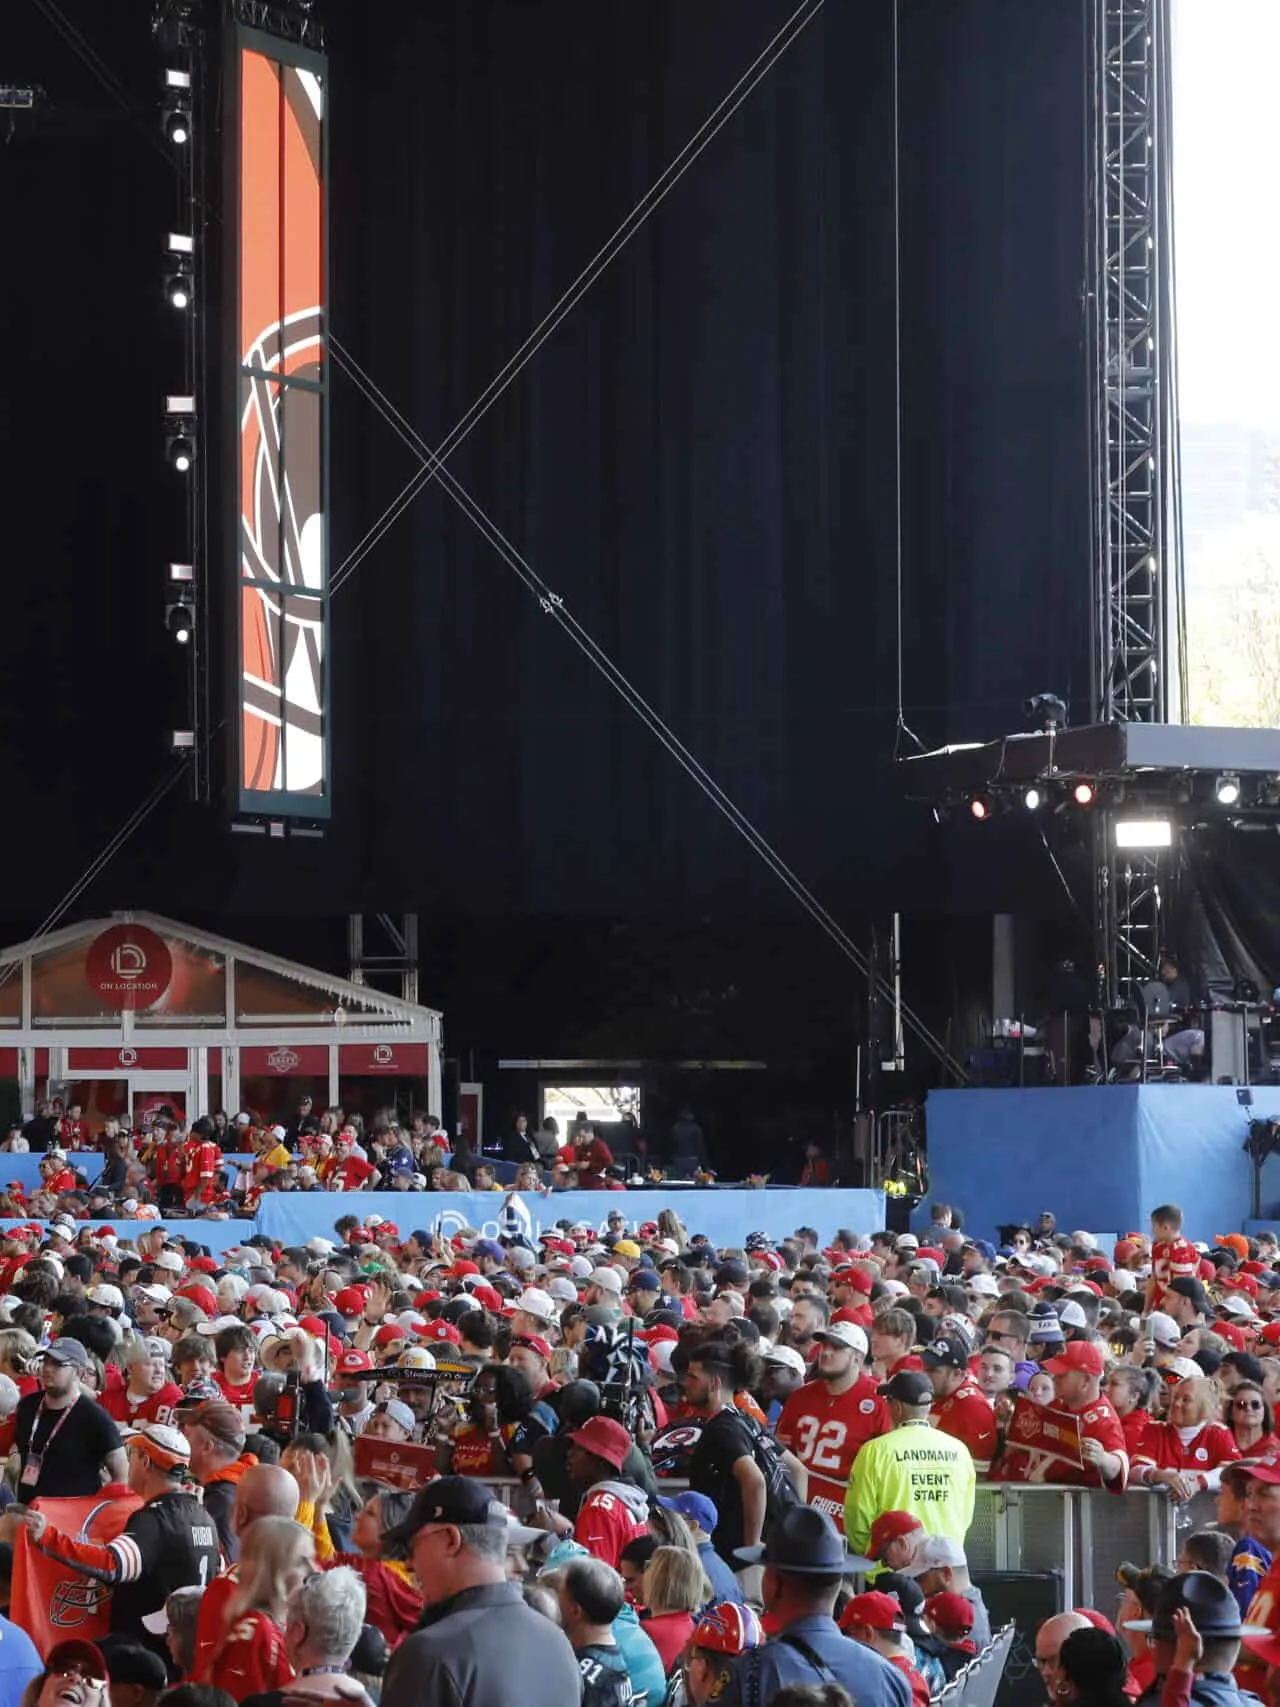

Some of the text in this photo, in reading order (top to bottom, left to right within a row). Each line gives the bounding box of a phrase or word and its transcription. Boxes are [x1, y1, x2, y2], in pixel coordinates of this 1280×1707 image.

[797, 1416, 848, 1469] 32
[895, 1448, 959, 1464] LANDMARK
[911, 1472, 951, 1486] EVENT
[913, 1488, 950, 1502] STAFF
[579, 1658, 603, 1684] 91
